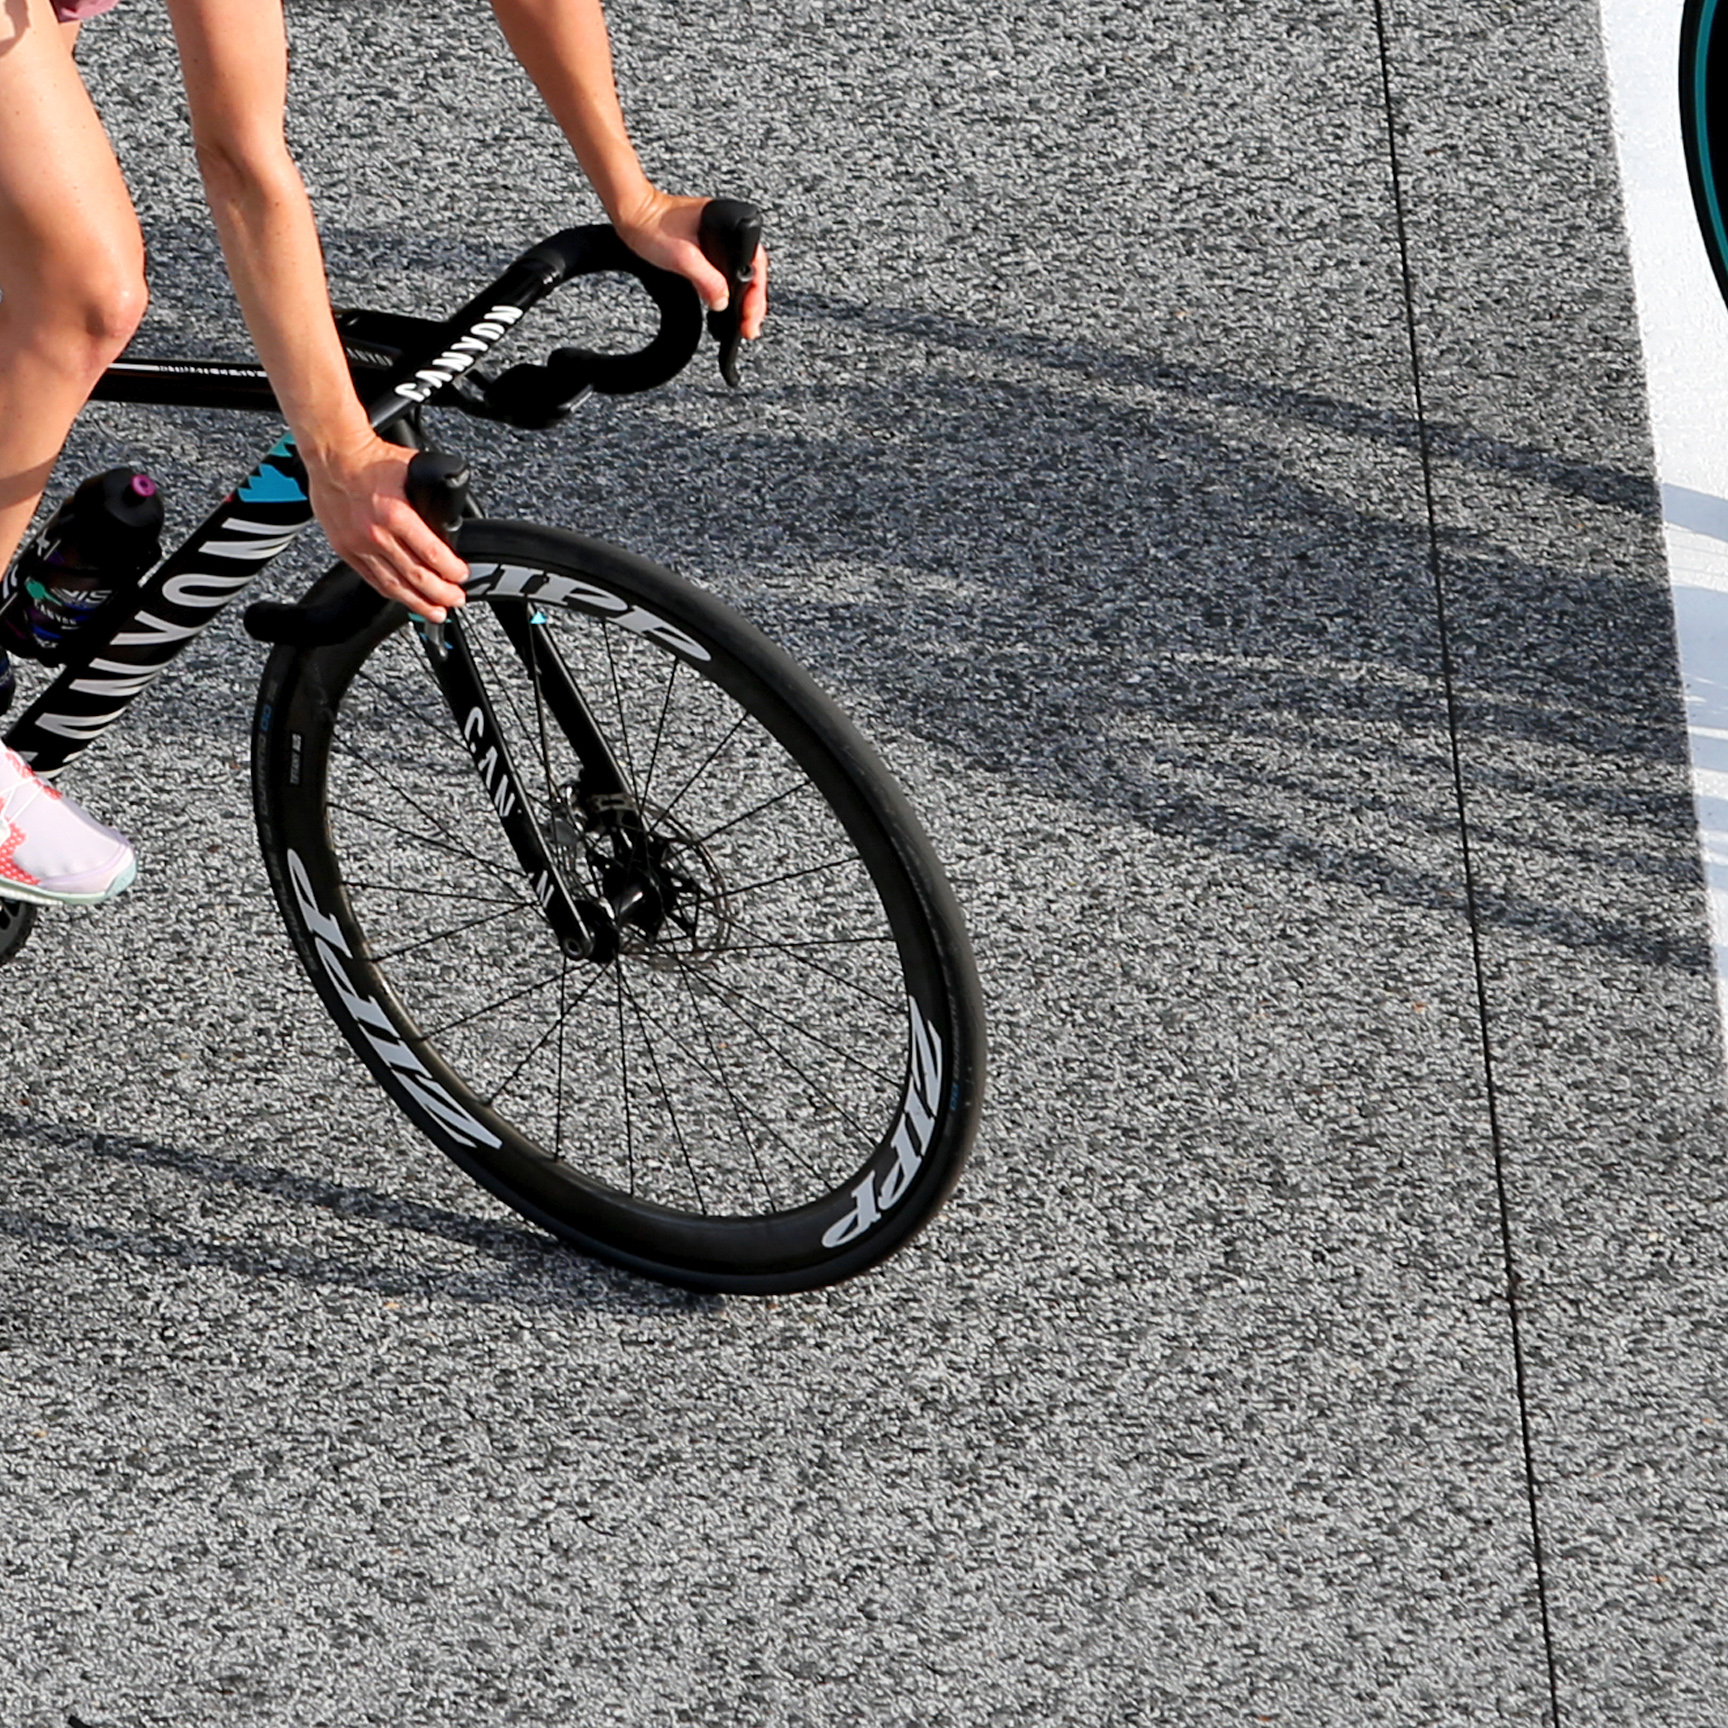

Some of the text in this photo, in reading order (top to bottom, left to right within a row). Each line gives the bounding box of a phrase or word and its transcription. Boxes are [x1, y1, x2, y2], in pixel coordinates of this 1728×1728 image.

[394, 305, 524, 403] CANYON
[464, 706, 555, 909] CANN
[287, 848, 503, 1150] ZIPP
[821, 995, 943, 1249] ZIPP
